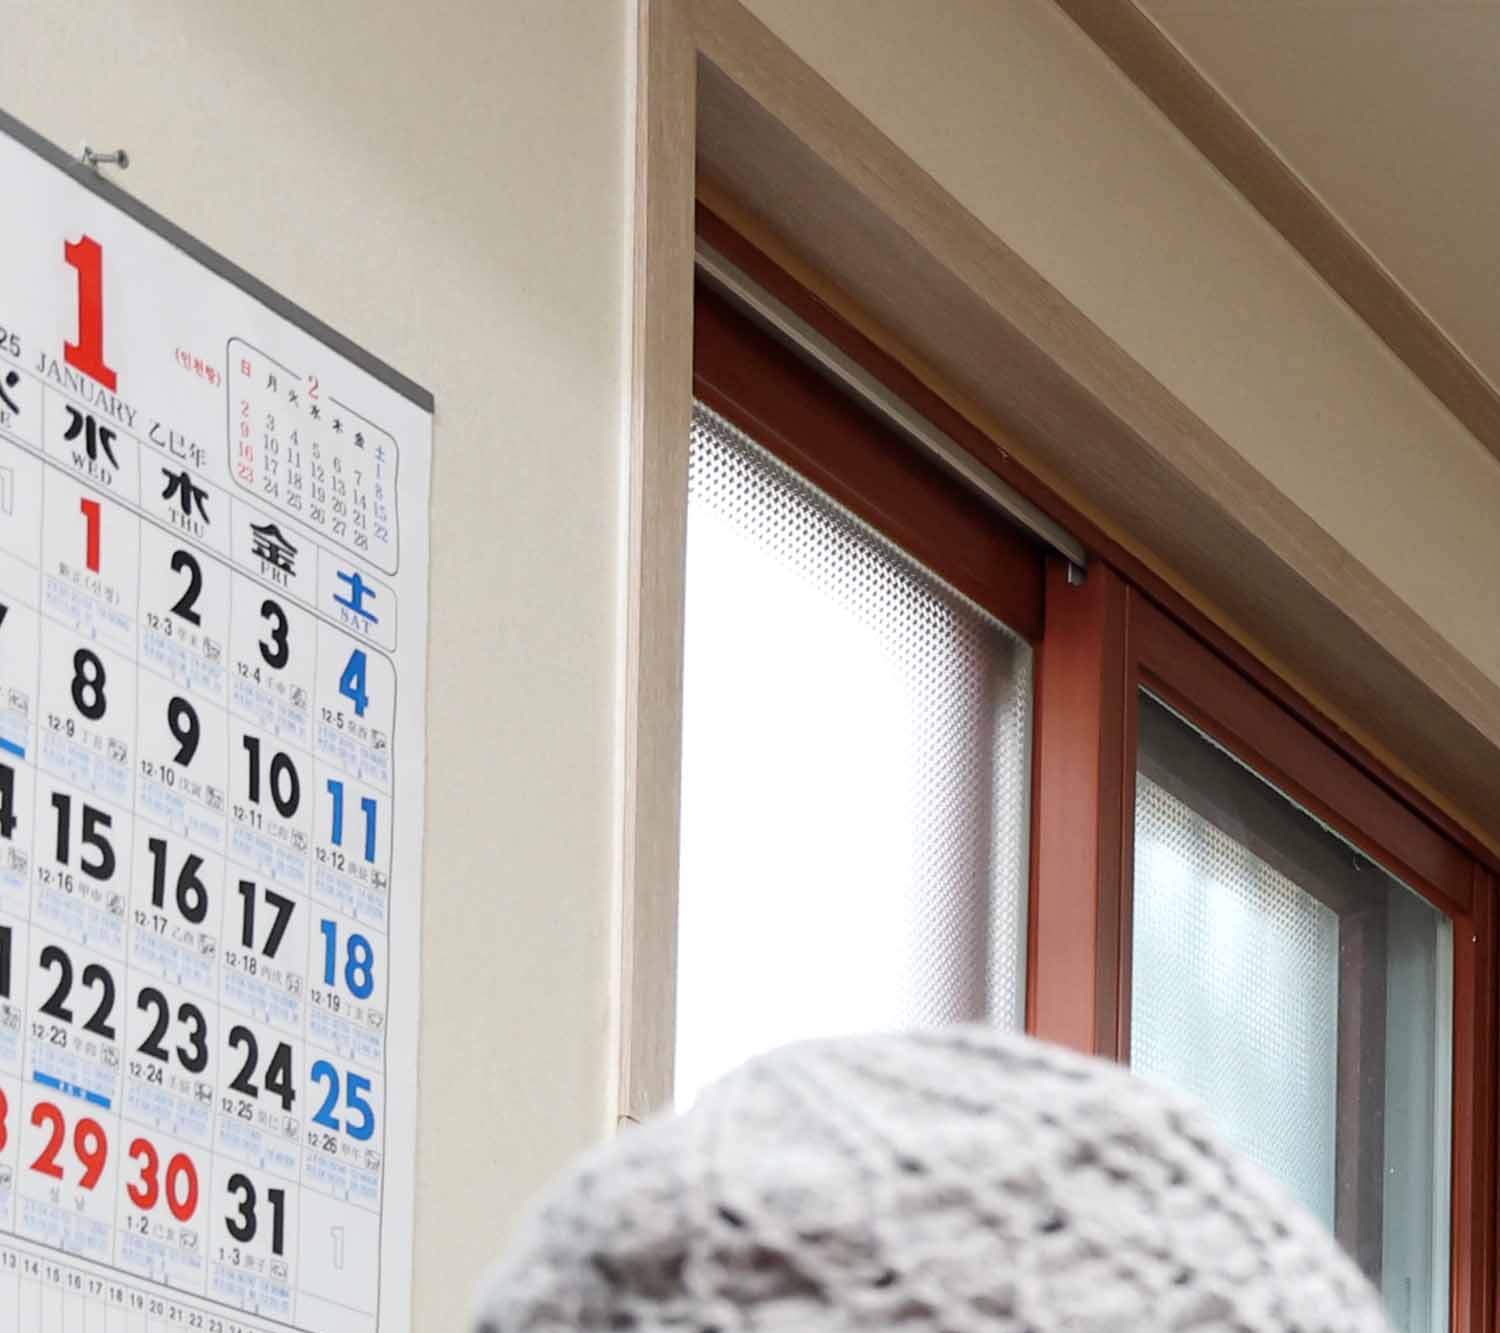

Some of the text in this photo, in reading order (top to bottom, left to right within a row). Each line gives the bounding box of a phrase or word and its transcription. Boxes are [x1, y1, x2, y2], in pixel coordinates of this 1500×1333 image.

[36, 352, 138, 428] JANUARY
[64, 234, 118, 395] 1
[306, 375, 320, 401] 2
[63, 404, 120, 471] 水
[249, 523, 299, 578] 金
[333, 569, 379, 625] 土
[71, 451, 372, 634] WED THU FRI SAT
[80, 496, 101, 574] 1
[170, 549, 203, 627] 2
[259, 598, 290, 670] 3
[339, 648, 369, 717] 4
[72, 647, 377, 865] 8 9 10 11
[51, 791, 374, 1001] 15 16 17 18
[38, 944, 375, 1142] 22 23 24 25
[30, 1101, 109, 1191] 29
[126, 1137, 199, 1223] 30
[224, 1172, 285, 1256] 31
[2, 1251, 17, 1269] 13
[24, 1258, 39, 1275] 14
[47, 1266, 61, 1283] 15
[68, 1273, 82, 1289] 16
[88, 1280, 103, 1295] 17
[109, 1287, 123, 1303] 18
[130, 1293, 144, 1309] 19
[149, 1299, 164, 1316] 20
[169, 1306, 183, 1321] 21
[189, 1312, 203, 1329] 22
